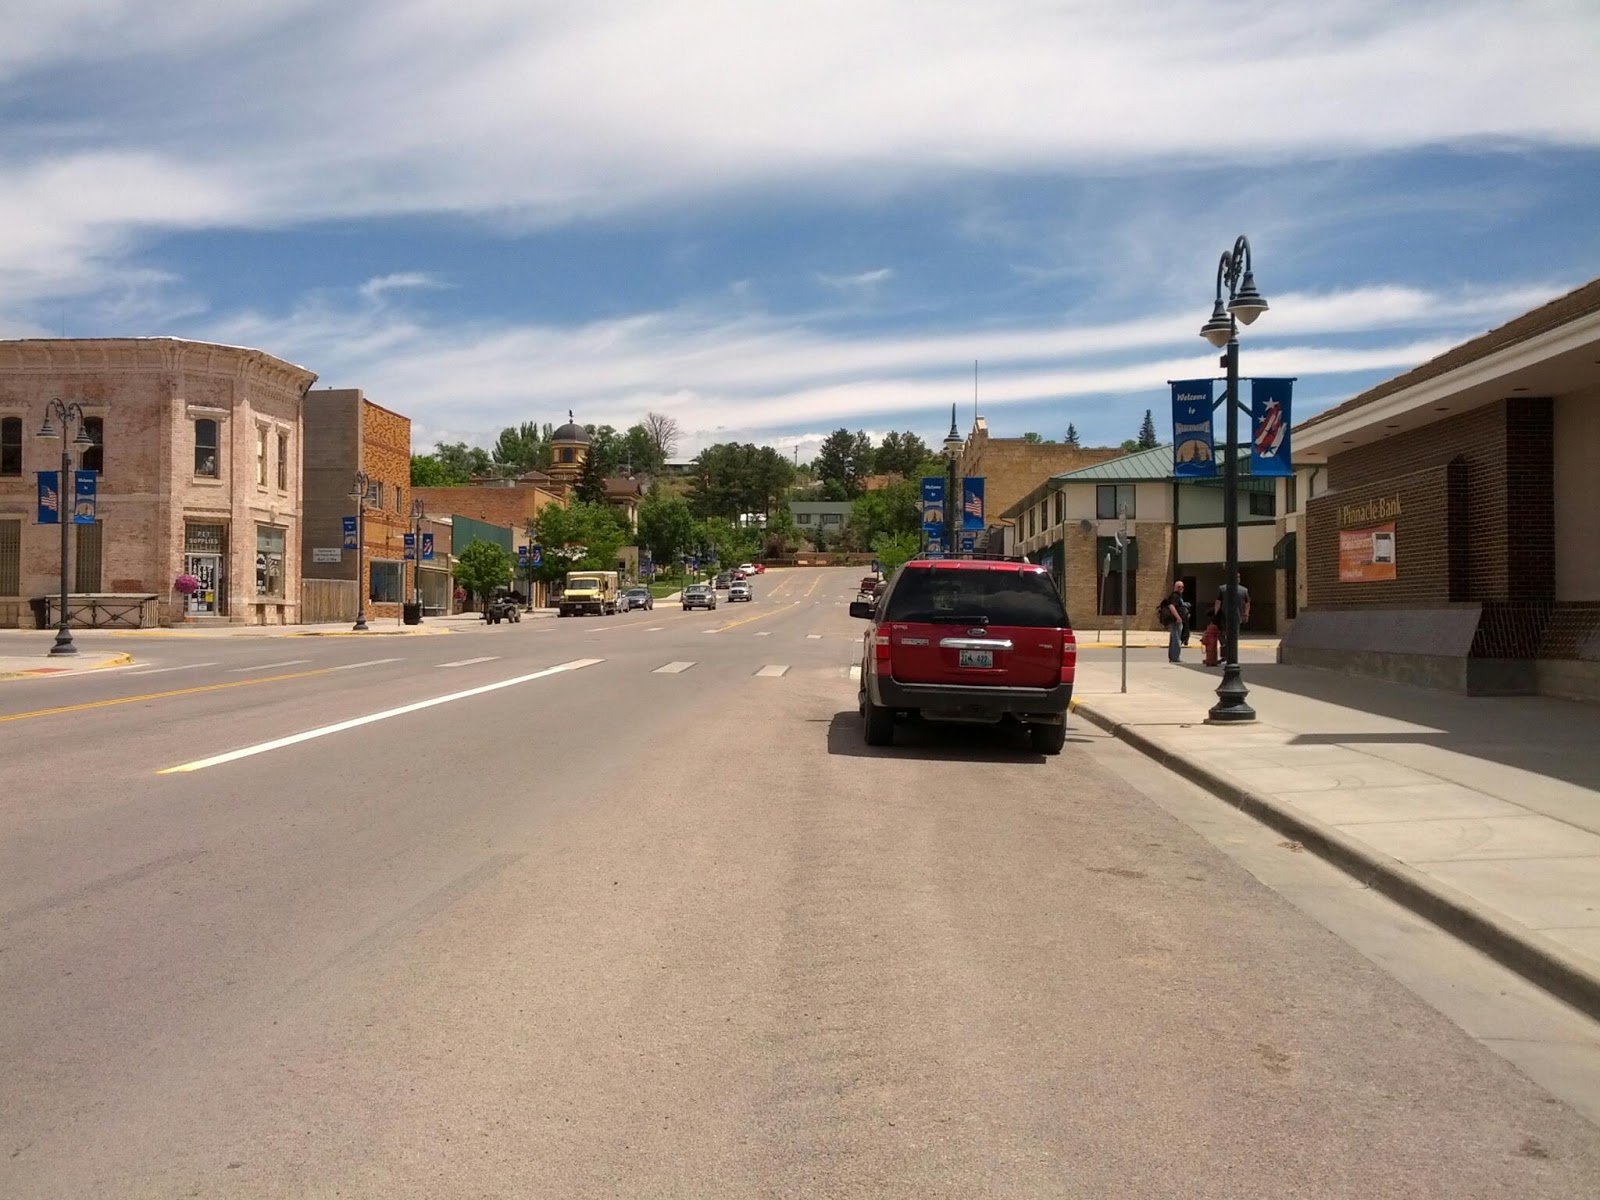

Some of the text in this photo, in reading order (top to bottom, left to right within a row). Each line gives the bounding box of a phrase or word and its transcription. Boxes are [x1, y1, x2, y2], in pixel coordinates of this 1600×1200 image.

[1177, 393, 1206, 402] Welcome
[1189, 407, 1196, 415] to
[1343, 493, 1402, 525] Pinnacle Bank
